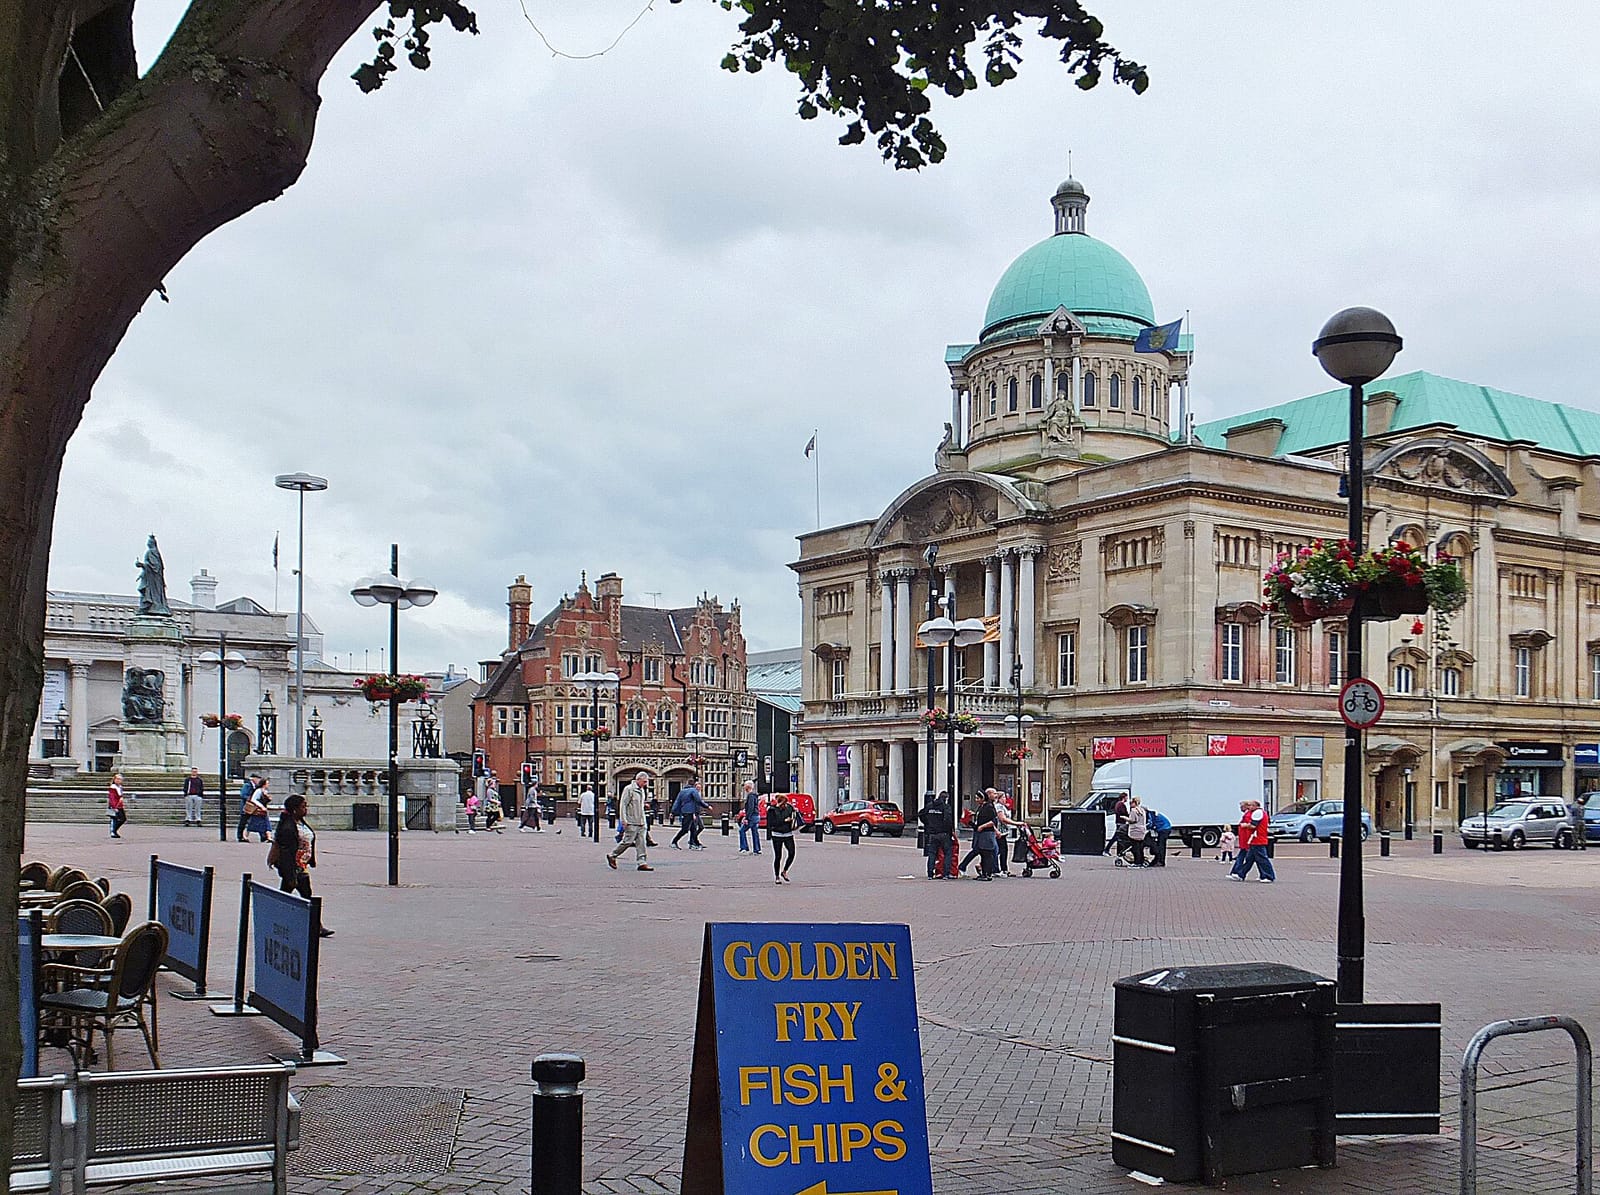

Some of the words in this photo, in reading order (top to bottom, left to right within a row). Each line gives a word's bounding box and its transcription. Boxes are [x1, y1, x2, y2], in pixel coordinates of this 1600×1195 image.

[662, 742, 686, 750] HOTEL
[264, 936, 301, 982] NERO
[723, 941, 899, 982] GOLDEN
[774, 1001, 862, 1042] FRY
[739, 1063, 854, 1106] FISH
[873, 1062, 908, 1103] &
[749, 1119, 907, 1167] CHIPS
